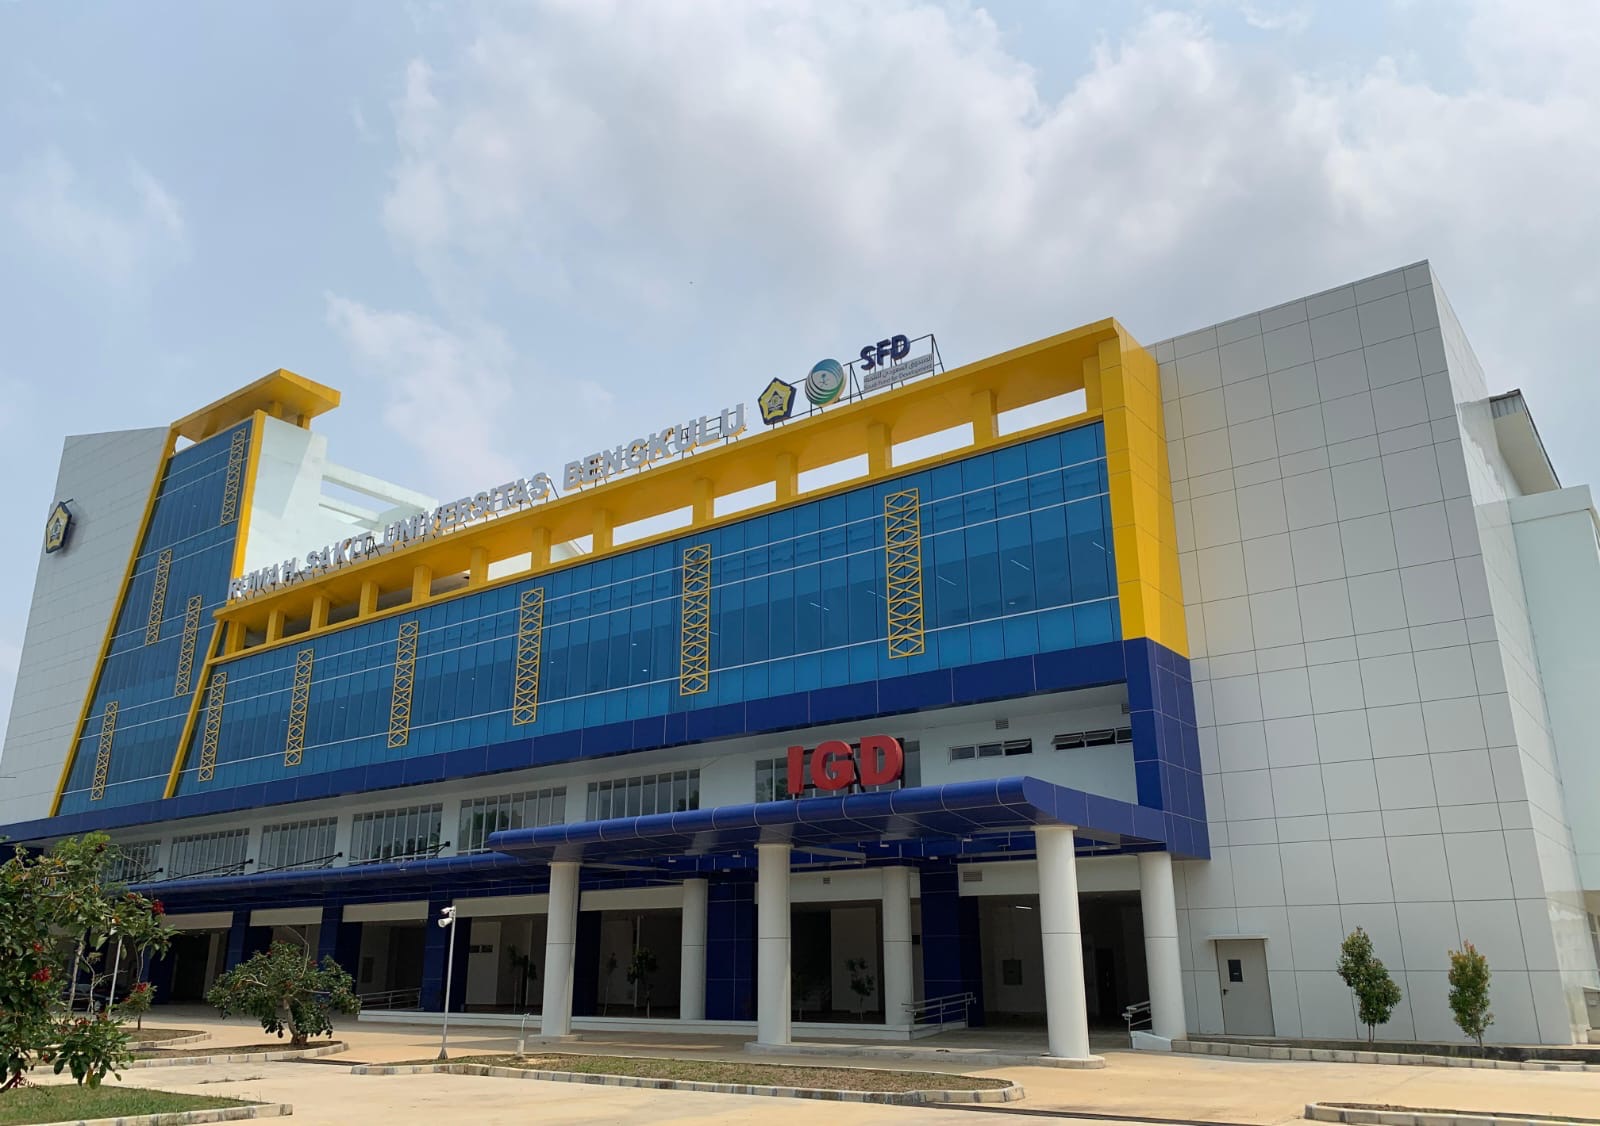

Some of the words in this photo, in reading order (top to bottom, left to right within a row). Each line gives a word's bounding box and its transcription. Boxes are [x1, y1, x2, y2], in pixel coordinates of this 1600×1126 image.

[860, 334, 911, 371] SFD
[227, 557, 297, 600] RUMAH
[305, 531, 372, 574] SAKIT
[384, 472, 551, 548] UNIVERSITAS
[563, 403, 745, 491] BENGKULU
[787, 733, 903, 795] IGD
